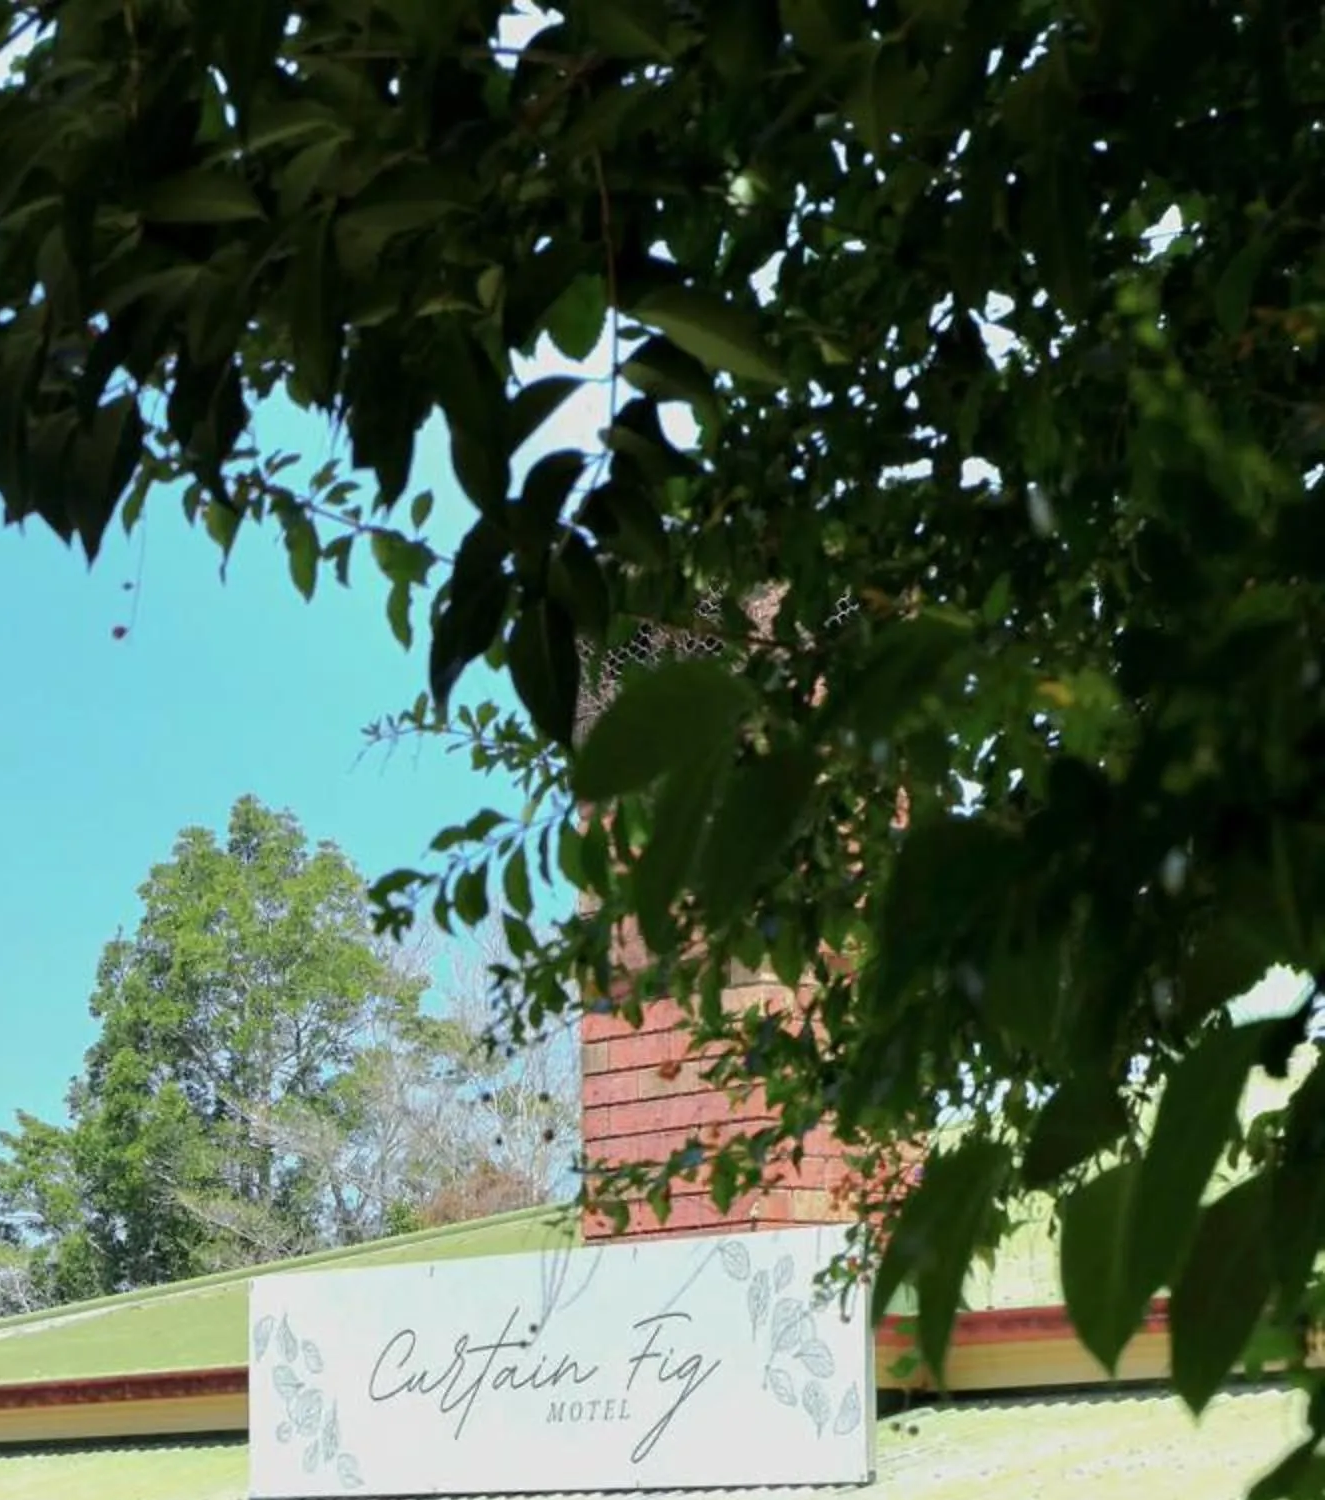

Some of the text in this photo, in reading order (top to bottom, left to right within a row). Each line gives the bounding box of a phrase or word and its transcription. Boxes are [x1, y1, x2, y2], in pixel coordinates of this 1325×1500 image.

[369, 1306, 721, 1463] Curtain Fig
[546, 1399, 632, 1423] MOTEL
